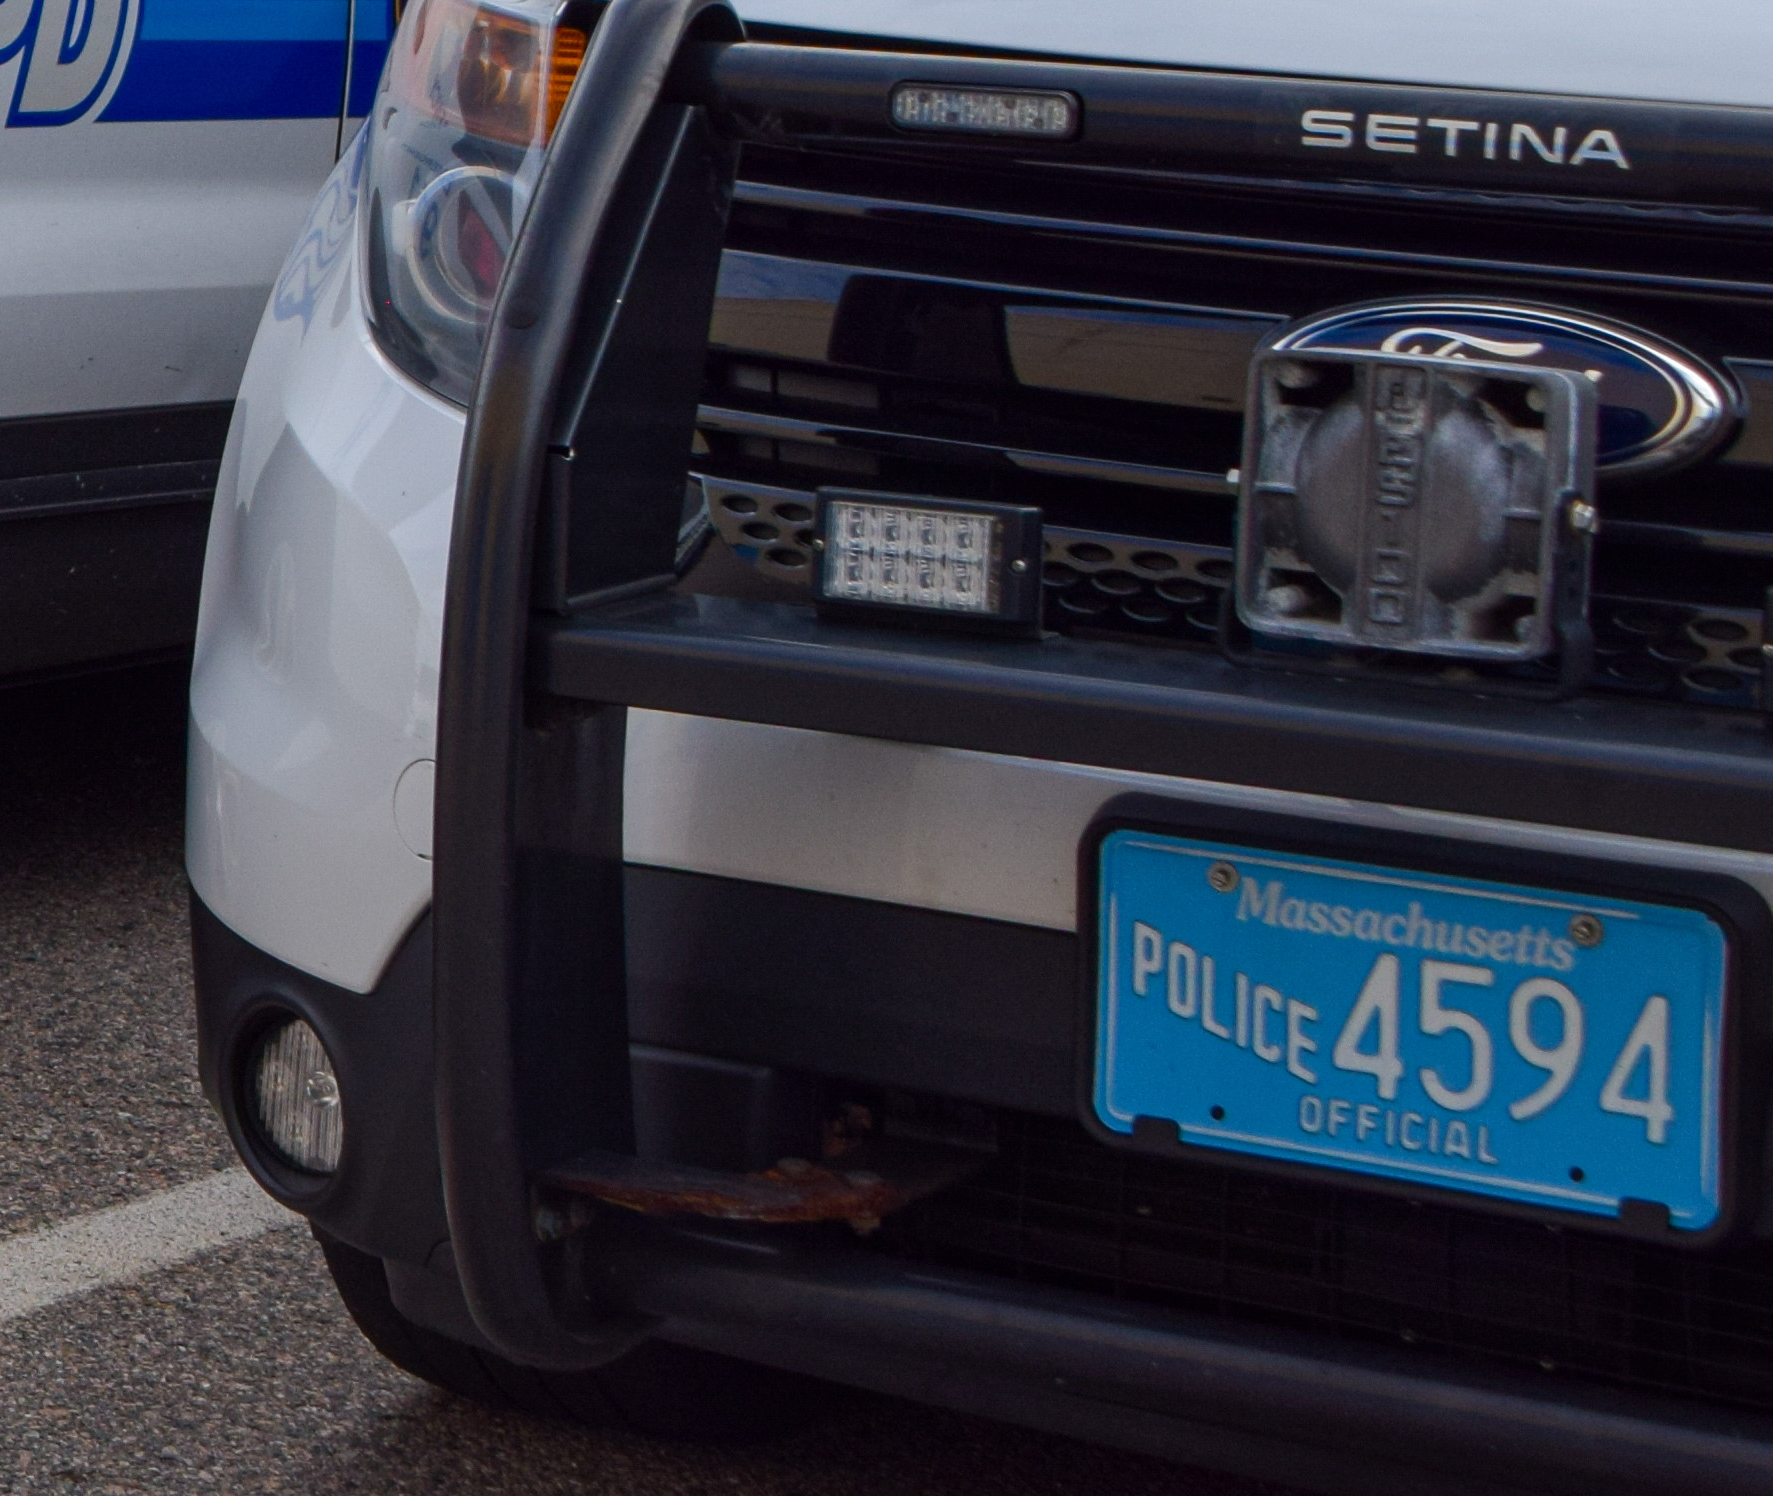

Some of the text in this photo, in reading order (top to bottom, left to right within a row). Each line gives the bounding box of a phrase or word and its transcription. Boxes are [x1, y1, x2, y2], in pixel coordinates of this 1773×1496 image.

[1301, 109, 1633, 171] SETINA
[1236, 876, 1577, 972] Massachusetts
[1132, 920, 1676, 1145] POLICE 4594
[1299, 1095, 1499, 1165] OFFICIAL
